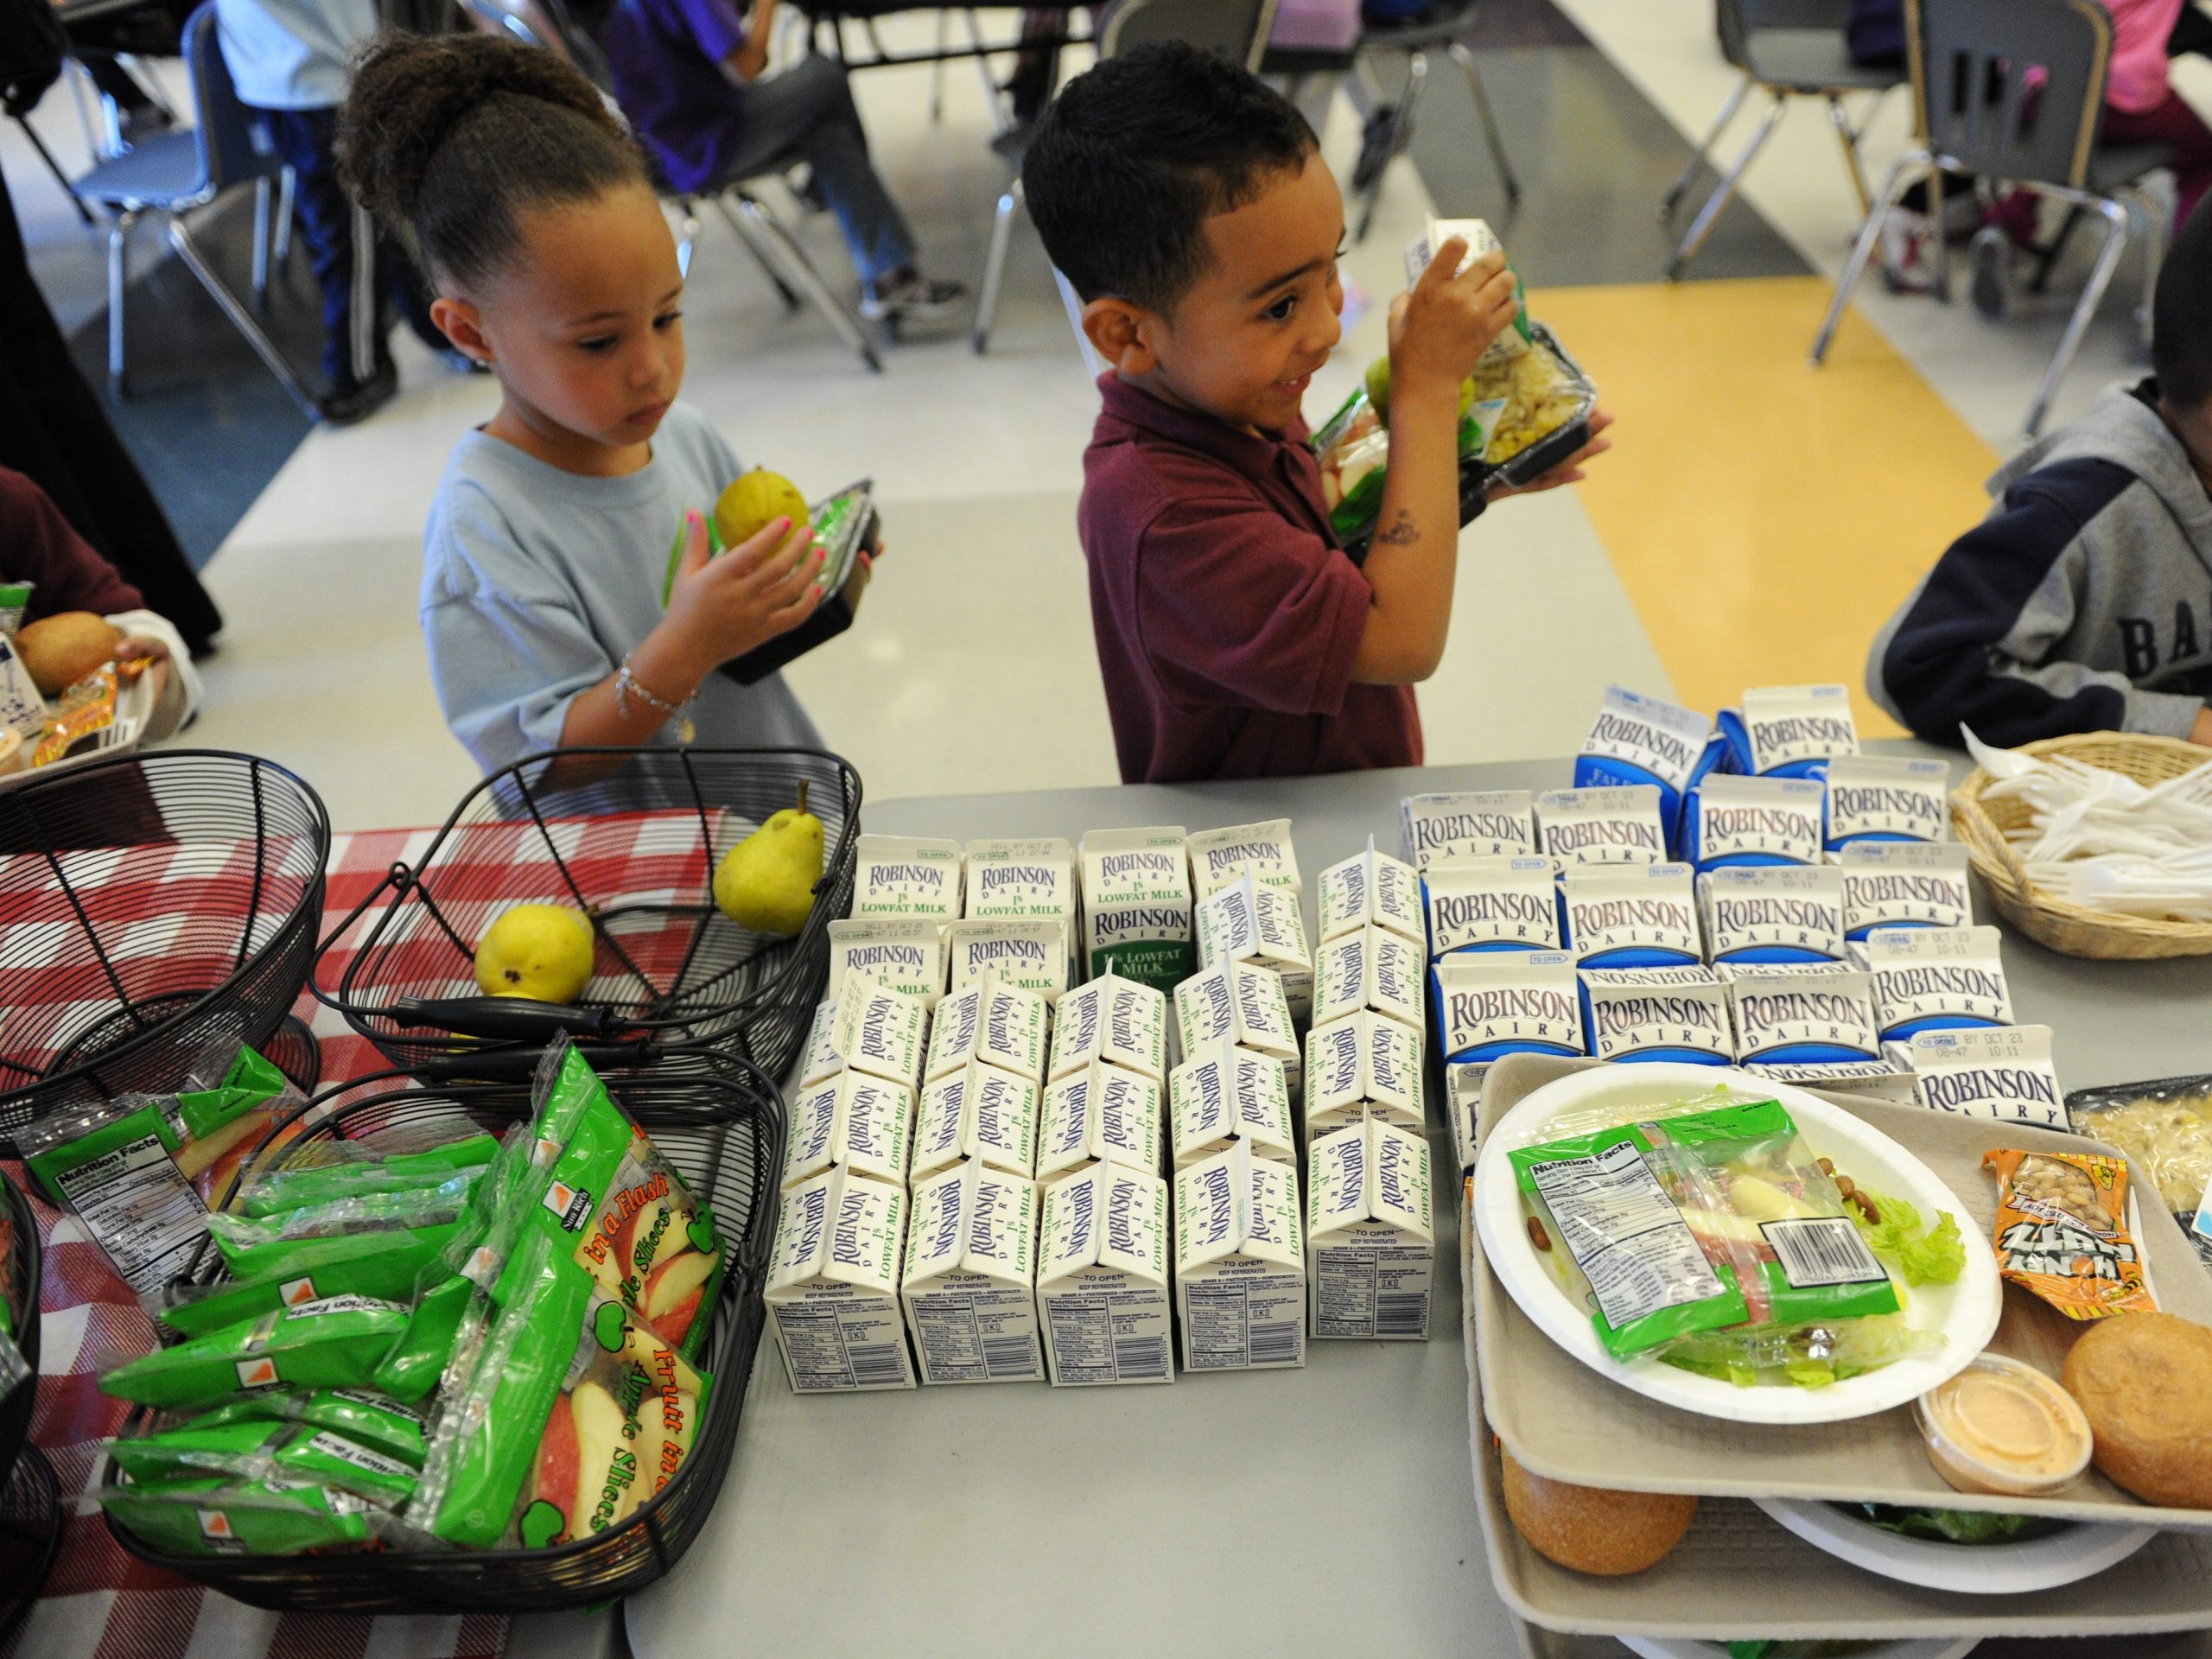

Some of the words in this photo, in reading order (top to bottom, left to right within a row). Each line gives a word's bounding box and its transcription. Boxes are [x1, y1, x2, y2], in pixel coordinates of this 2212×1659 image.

[2118, 600, 2212, 678] BA
[1589, 713, 1695, 770] ROBINSON
[1753, 717, 1853, 754] ROBINSON
[1704, 807, 1817, 849] ROBINSON
[1832, 787, 1942, 824] ROBINSON
[1207, 842, 1281, 871] ROBINSON
[1415, 814, 1527, 850] ROBINSON
[1545, 821, 1658, 855] ROBINSON
[869, 864, 944, 887] ROBINSON
[981, 867, 1055, 890] ROBINSON
[1101, 854, 1174, 877] ROBINSON
[861, 903, 911, 912] LOWFAT
[914, 903, 946, 913] MILK
[1098, 893, 1147, 903] LOWFAT
[1151, 890, 1183, 899] MILK
[1342, 864, 1363, 918] ROBINSON
[1379, 863, 1401, 918] ROBINSON
[1434, 893, 1553, 932] ROBINSON
[1845, 875, 1965, 908] ROBINSON
[1094, 908, 1188, 936] ROBINSON
[1222, 892, 1245, 950] ROBINSON
[1256, 890, 1284, 946] ROBINSON
[1573, 900, 1689, 938] ROBINSON
[1716, 899, 1839, 936] ROBINSON
[847, 946, 924, 969] ROBINSON
[968, 940, 1046, 965] ROBINSON
[1122, 963, 1164, 974] MILK
[1338, 941, 1362, 1003] ROBINSON
[1377, 939, 1400, 1003] ROBINSON
[896, 984, 931, 994] MILK
[1018, 978, 1052, 988] MILK
[1202, 975, 1231, 1039] ROBINSON
[1238, 971, 1270, 1033] ROBINSON
[1874, 967, 2005, 1007] ROBINSON
[861, 995, 893, 1060] ROBINSON
[907, 1004, 920, 1029] MILK
[950, 993, 979, 1056] ROBINSON
[988, 993, 1014, 1054] ROBINSON
[1031, 1000, 1040, 1028] MILK
[1072, 990, 1098, 1054] ROBINSON
[1112, 988, 1138, 1053] ROBINSON
[1450, 989, 1576, 1032] ROBINSON
[1595, 998, 1722, 1037] ROBINSON
[1741, 994, 1868, 1032] ROBINSON
[901, 1030, 918, 1075] LOWFAT
[1028, 1029, 1037, 1070] LOWFAT
[1150, 1025, 1160, 1068] LOWFAT
[1332, 1027, 1357, 1096] ROBINSON
[1375, 1024, 1397, 1093] ROBINSON
[1986, 1034, 2005, 1043] OCT
[2010, 1034, 2023, 1043] 23
[978, 1077, 1008, 1148] ROBINSON
[1023, 1085, 1033, 1115] MILK
[1103, 1077, 1130, 1148] ROBINSON
[1145, 1085, 1155, 1117] MILK
[1195, 1062, 1220, 1133] ROBINSON
[1237, 1058, 1265, 1126] ROBINSON
[1922, 1070, 2057, 1112] ROBINSON
[804, 1089, 836, 1160] ROBINSON
[848, 1085, 880, 1156] ROBINSON
[935, 1081, 964, 1153] ROBINSON
[1019, 1117, 1033, 1164] LOWFAT
[1060, 1081, 1088, 1153] ROBINSON
[1143, 1117, 1154, 1165] LOWFAT
[1276, 1096, 1290, 1141] LOWFAT
[59, 1155, 119, 1185] Nutrition
[119, 1138, 158, 1157] Facts
[1338, 1138, 1363, 1212] ROBINSON
[1379, 1135, 1406, 1211] ROBINSON
[1533, 1159, 1592, 1175] Nutrition
[1595, 1142, 1631, 1162] Facts
[563, 1210, 578, 1230] Sun
[572, 1191, 588, 1211] Rich
[1020, 1185, 1031, 1218] MILK
[1154, 1185, 1164, 1218] MILK
[1204, 1166, 1230, 1244] ROBINSON
[1285, 1172, 1294, 1203] MILK
[1421, 1179, 1429, 1230] LOWFAT
[583, 1233, 610, 1265] in
[604, 1213, 620, 1235] a
[614, 1173, 669, 1221] Flash
[792, 1186, 827, 1267] ROBINSON
[834, 1189, 870, 1267] ROBINSON
[879, 1225, 895, 1280] LOWFAT
[887, 1193, 899, 1223] MILK
[931, 1179, 962, 1260] ROBINSON
[969, 1181, 1002, 1258] ROBINSON
[1065, 1179, 1094, 1258] ROBINSON
[1109, 1178, 1136, 1255] ROBINSON
[1284, 1205, 1299, 1256] LOWFAT
[634, 1208, 670, 1275] Slices
[1014, 1220, 1029, 1273] LOWFAT
[1152, 1218, 1163, 1273] LOWFAT
[621, 1360, 651, 1440] Apple
[653, 1350, 683, 1434] Fruit
[660, 1440, 683, 1474] in
[590, 1446, 636, 1533] Slices
